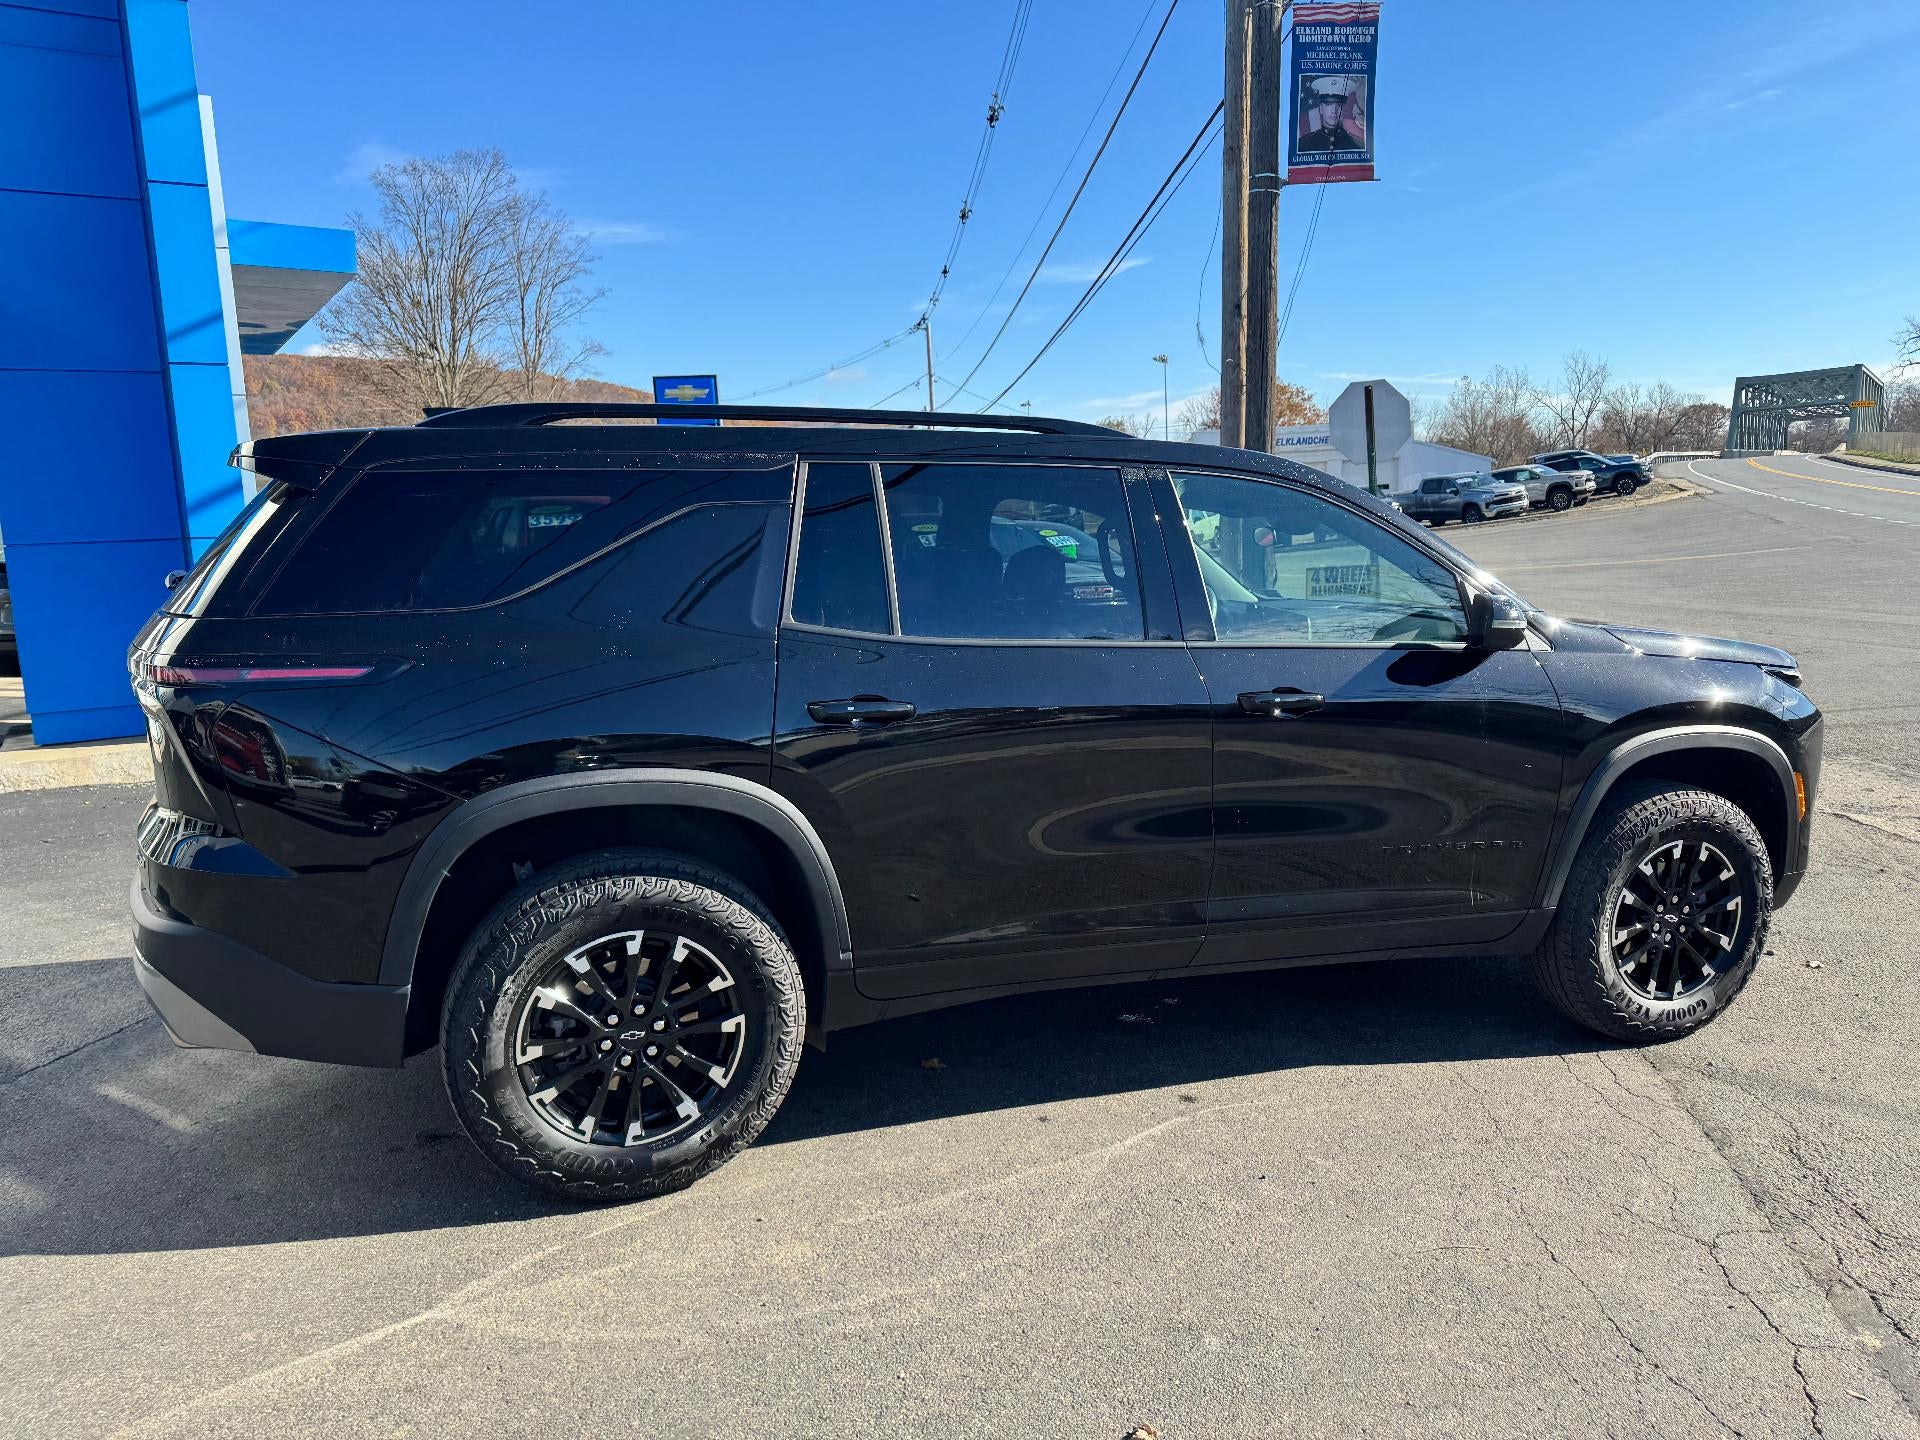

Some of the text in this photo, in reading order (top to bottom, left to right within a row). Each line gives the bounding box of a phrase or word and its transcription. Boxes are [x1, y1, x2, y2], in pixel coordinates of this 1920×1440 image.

[1295, 26, 1376, 35] ELKLAND BOROUGH
[1299, 34, 1372, 43] HOMETOWN HERO
[1306, 51, 1338, 59] MICHAEL
[1301, 61, 1368, 70] U.S. MARINE CORPS
[1292, 155, 1315, 163] GLOBAL
